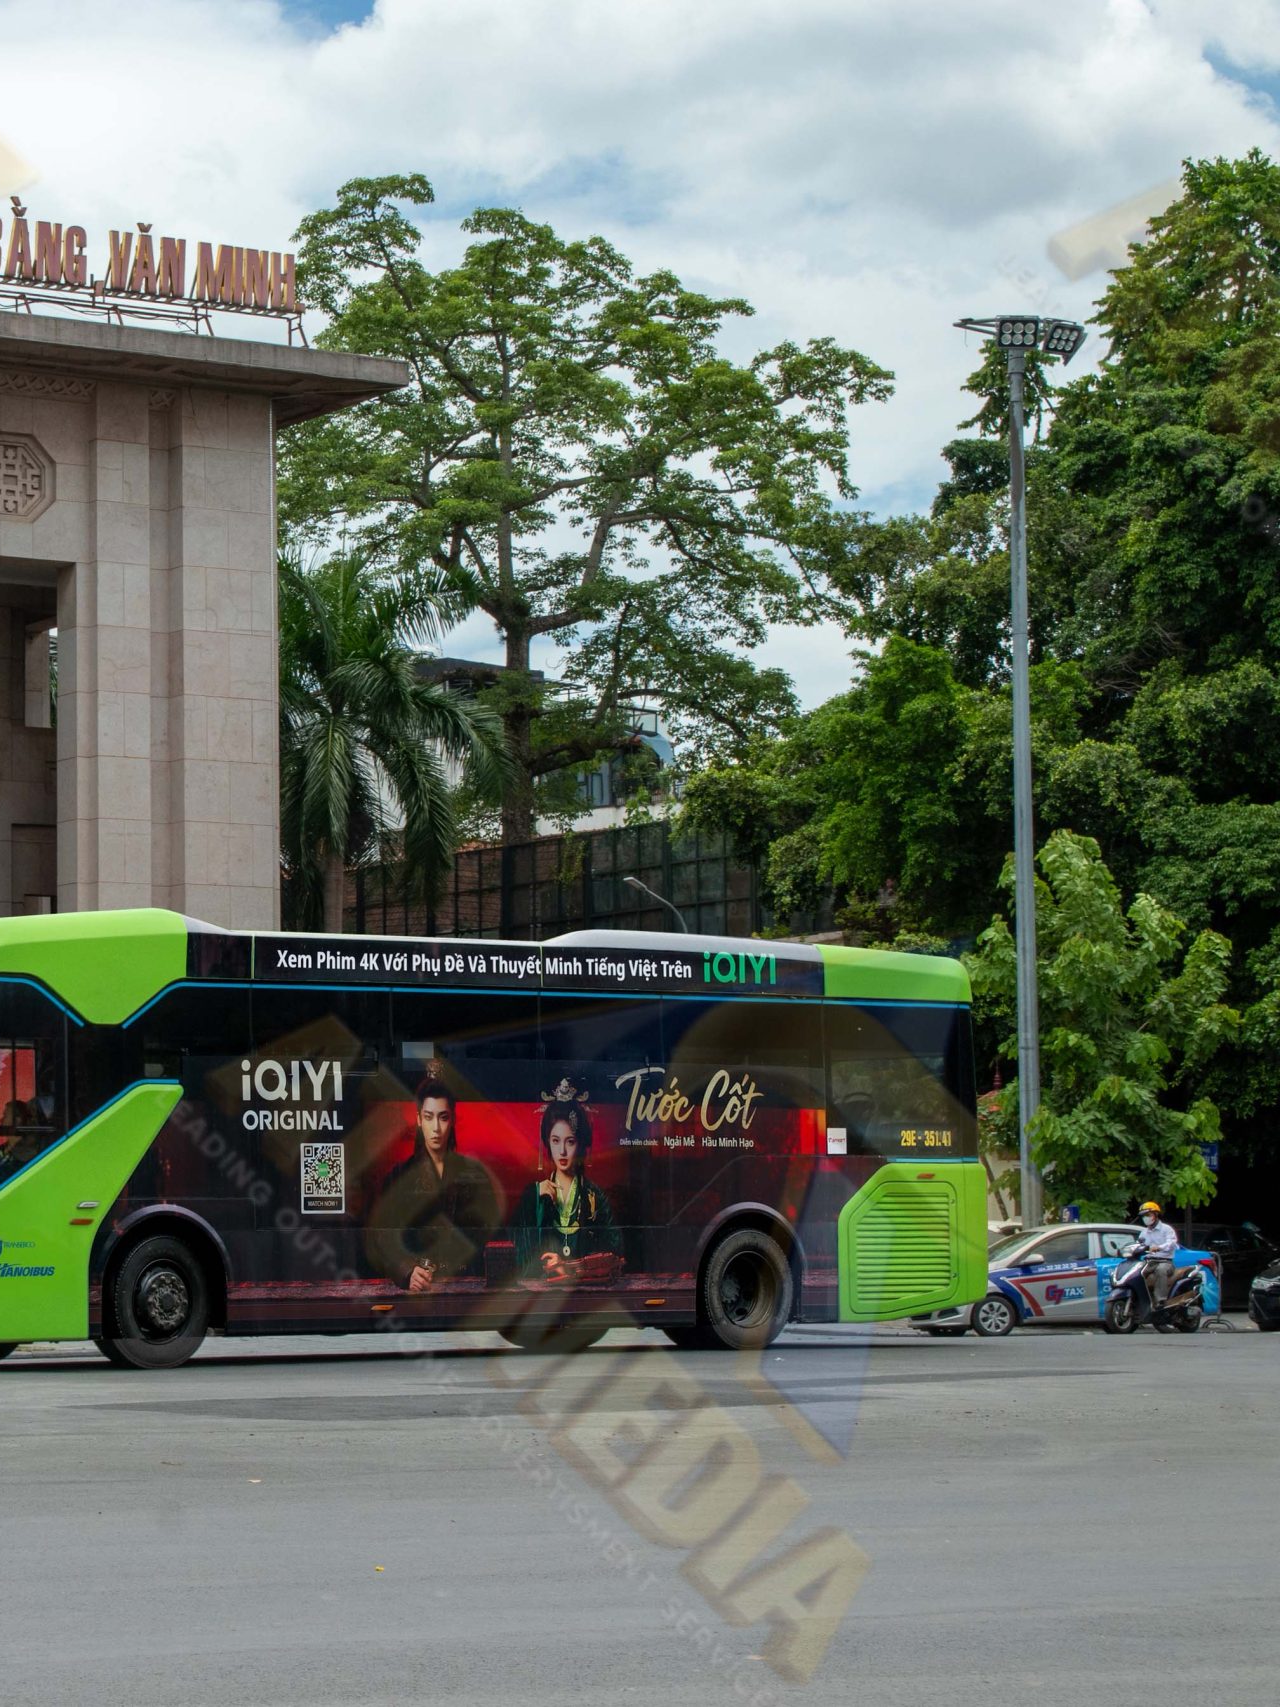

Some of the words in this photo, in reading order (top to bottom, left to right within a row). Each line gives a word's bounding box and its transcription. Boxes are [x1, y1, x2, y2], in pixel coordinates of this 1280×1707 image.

[109, 223, 187, 298] VĂN
[277, 950, 312, 969] Xem
[317, 951, 356, 970] Phim
[360, 953, 379, 971] 4K
[383, 952, 408, 972] Với
[412, 953, 441, 976] Phụ
[444, 953, 464, 973] Đề
[468, 955, 486, 974] Và
[490, 956, 541, 979] Thuyết
[546, 957, 582, 976] Minh
[586, 957, 625, 981] Tiếng
[629, 959, 657, 981] Việt
[661, 961, 692, 979] Trên
[615, 1066, 695, 1131] Tước
[700, 1069, 764, 1131] Cốt
[242, 1110, 344, 1131] ORIGINAL
[664, 1136, 682, 1149] Ngải
[701, 1137, 717, 1148] Hầu
[718, 1137, 737, 1148] Minh
[739, 1138, 755, 1150] Hạo
[901, 1130, 916, 1146] 29E
